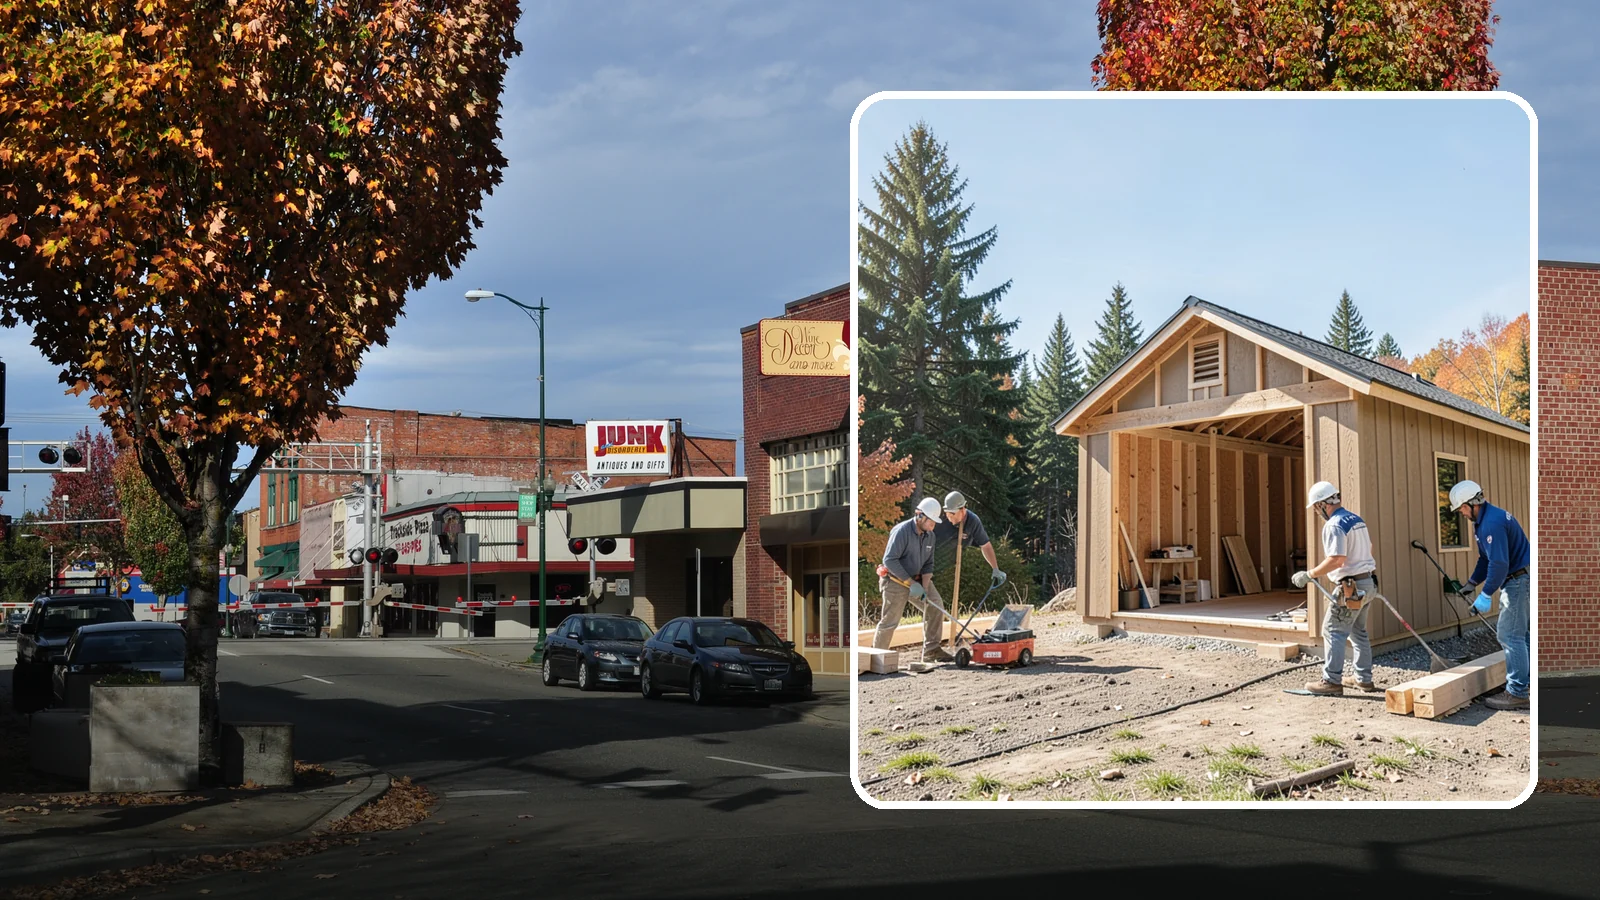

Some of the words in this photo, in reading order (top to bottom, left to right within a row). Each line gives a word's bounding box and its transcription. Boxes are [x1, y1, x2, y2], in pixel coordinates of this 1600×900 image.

[595, 425, 664, 457] JUNK
[607, 446, 646, 454] DISORDERLY
[596, 461, 628, 470] ANTIQUES
[631, 461, 643, 470] AND
[647, 460, 665, 469] GIFTS
[414, 519, 429, 535] Pizza
